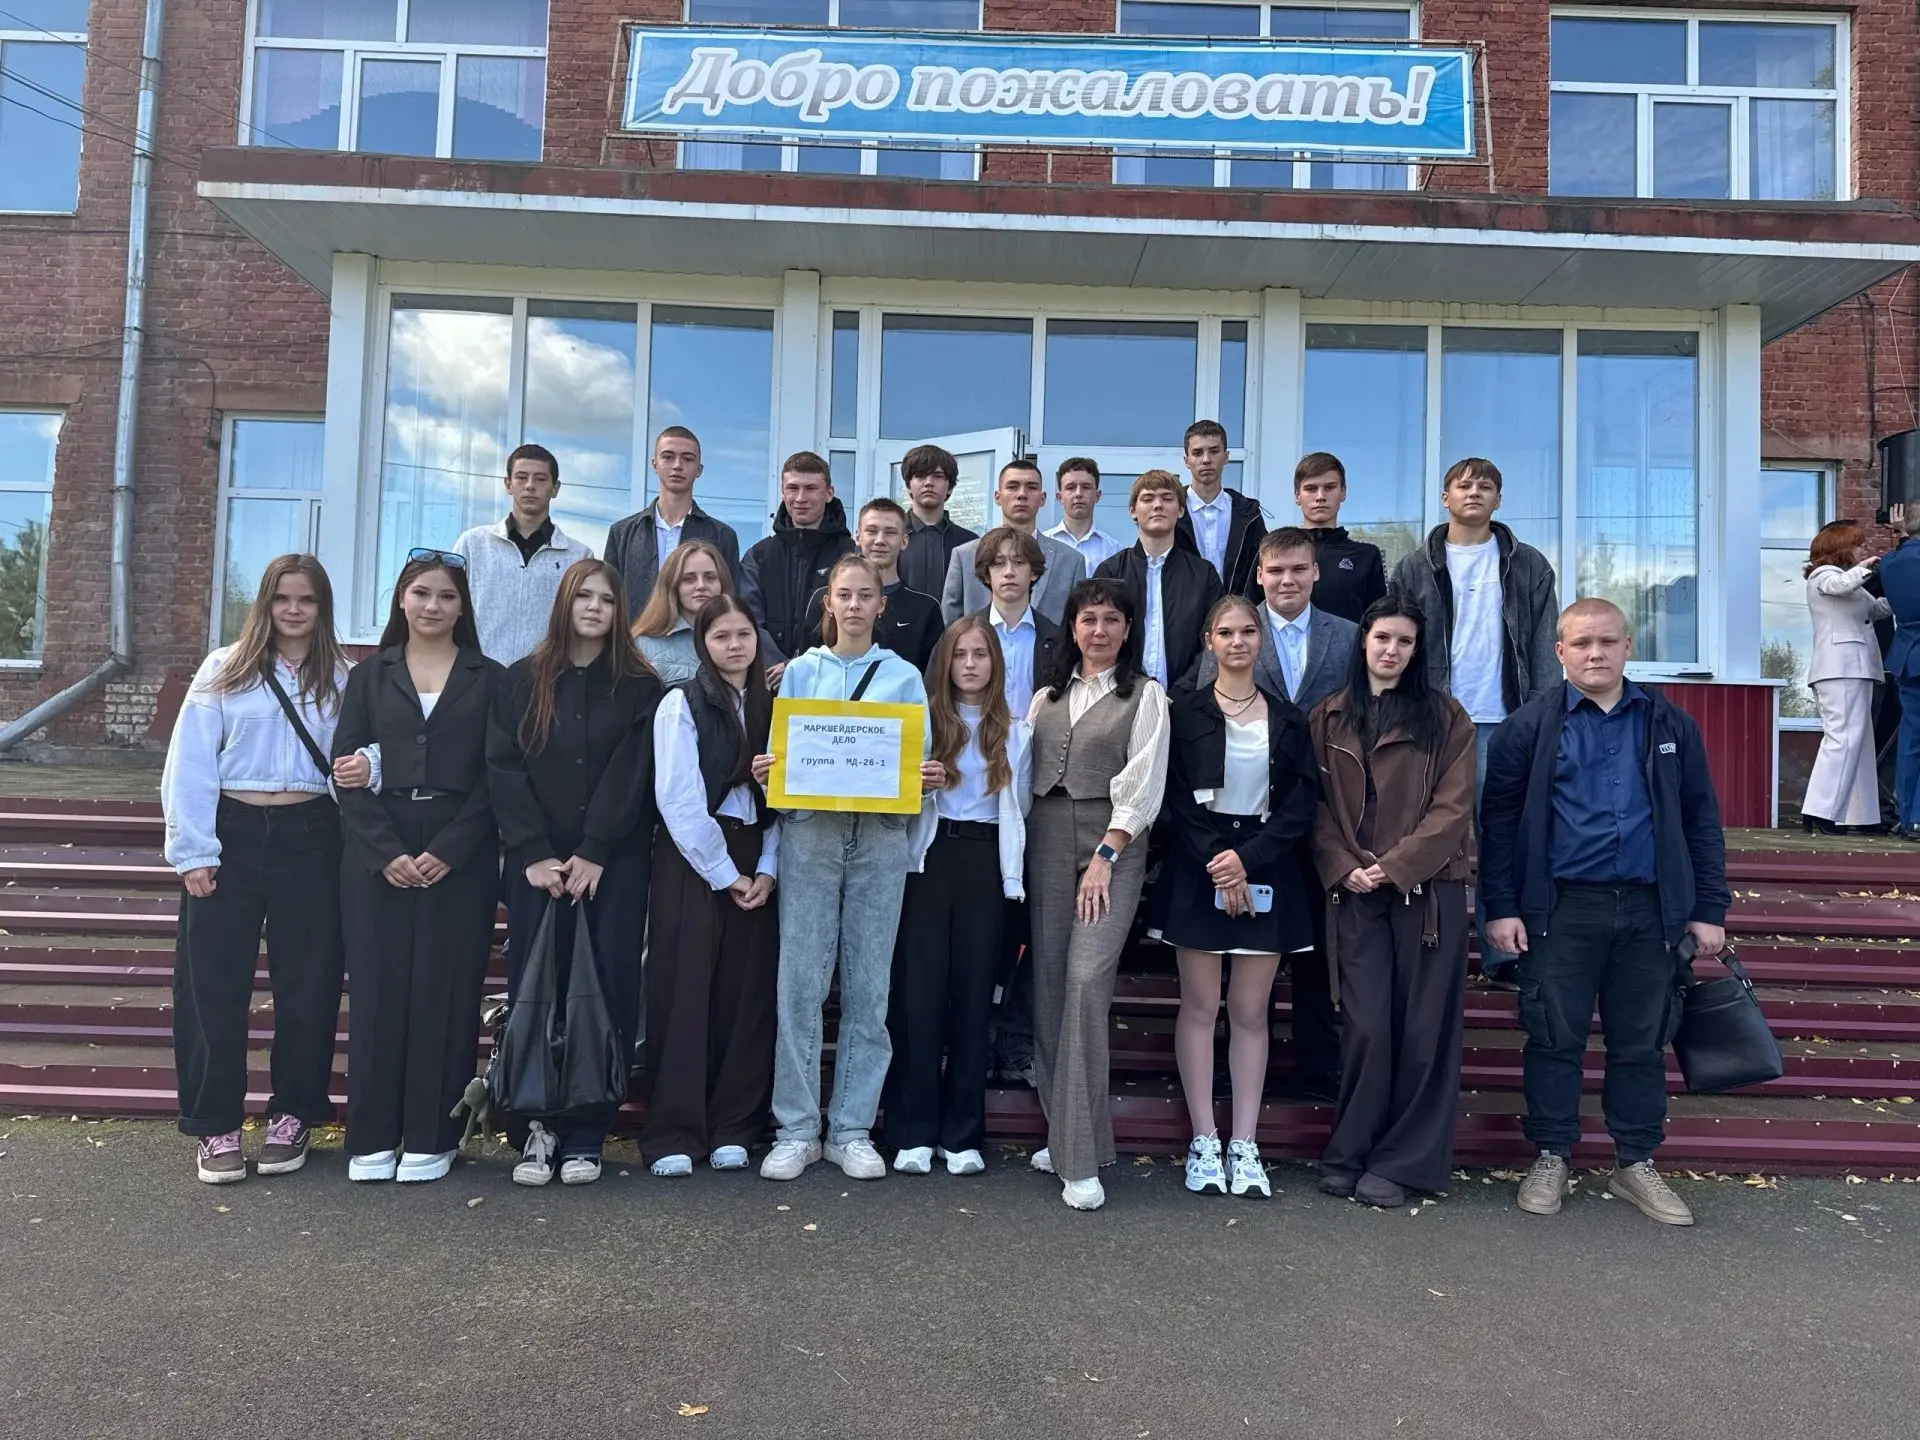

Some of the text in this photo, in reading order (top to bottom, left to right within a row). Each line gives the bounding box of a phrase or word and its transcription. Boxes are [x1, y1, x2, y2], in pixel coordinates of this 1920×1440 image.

[662, 48, 1436, 125] Добро пожаловать!
[803, 724, 885, 735] МАРКШЕЙДЕРСКОЕ
[832, 736, 856, 745] ДЕЛО
[801, 757, 886, 767] группа МД-26-1
